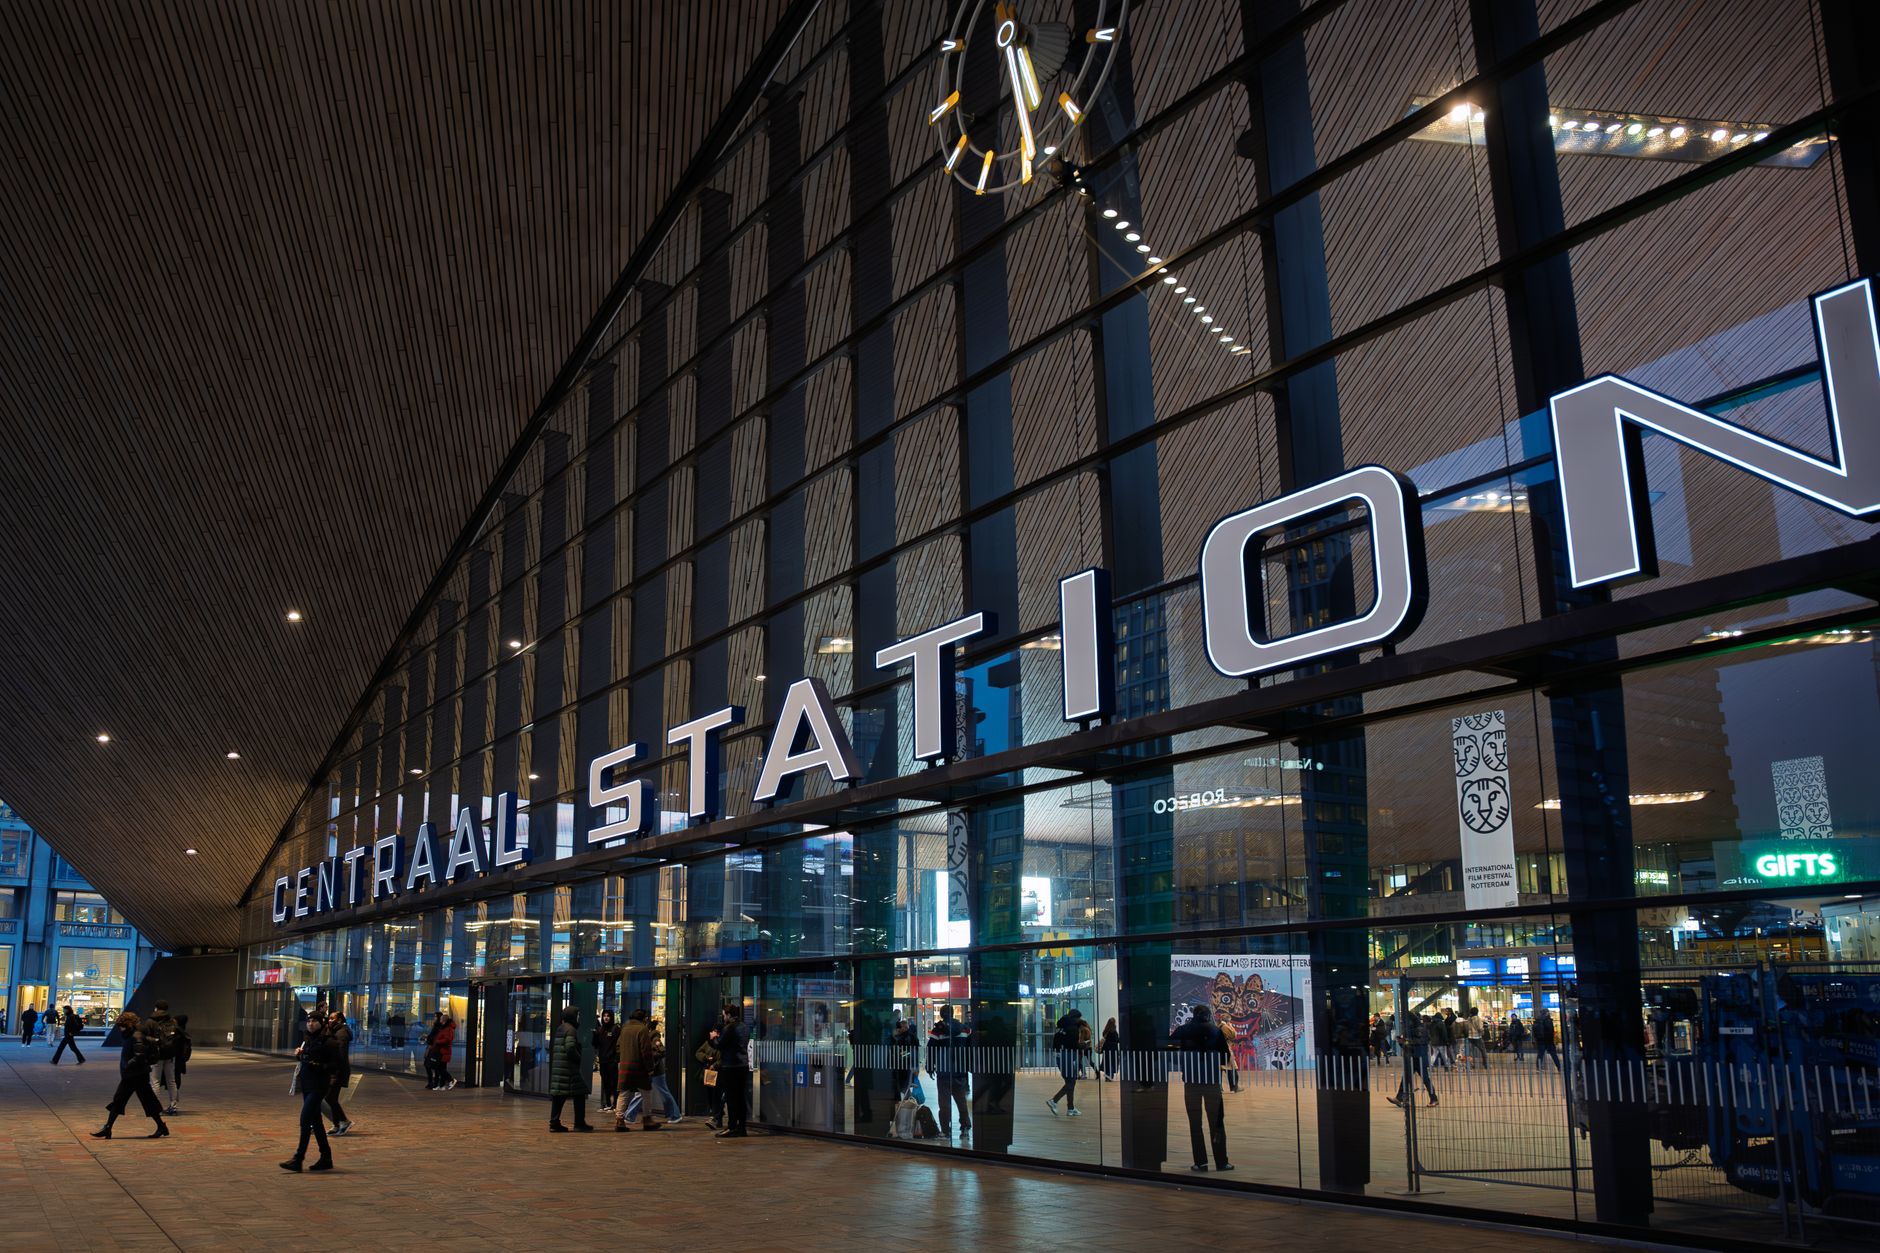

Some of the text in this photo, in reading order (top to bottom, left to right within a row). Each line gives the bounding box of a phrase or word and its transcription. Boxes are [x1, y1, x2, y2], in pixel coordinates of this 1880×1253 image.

[272, 278, 1880, 924] CENTRAAL STATION
[1465, 864, 1514, 873] INTERNATIONAL
[1756, 853, 1837, 878] GIFTS
[1483, 872, 1512, 880] FESTIVAL
[1471, 881, 1510, 889] ROTTERDAM
[1174, 959, 1216, 968] INTERNATIONAL
[1217, 959, 1240, 968] FILM
[1250, 958, 1281, 968] FESTIVAL
